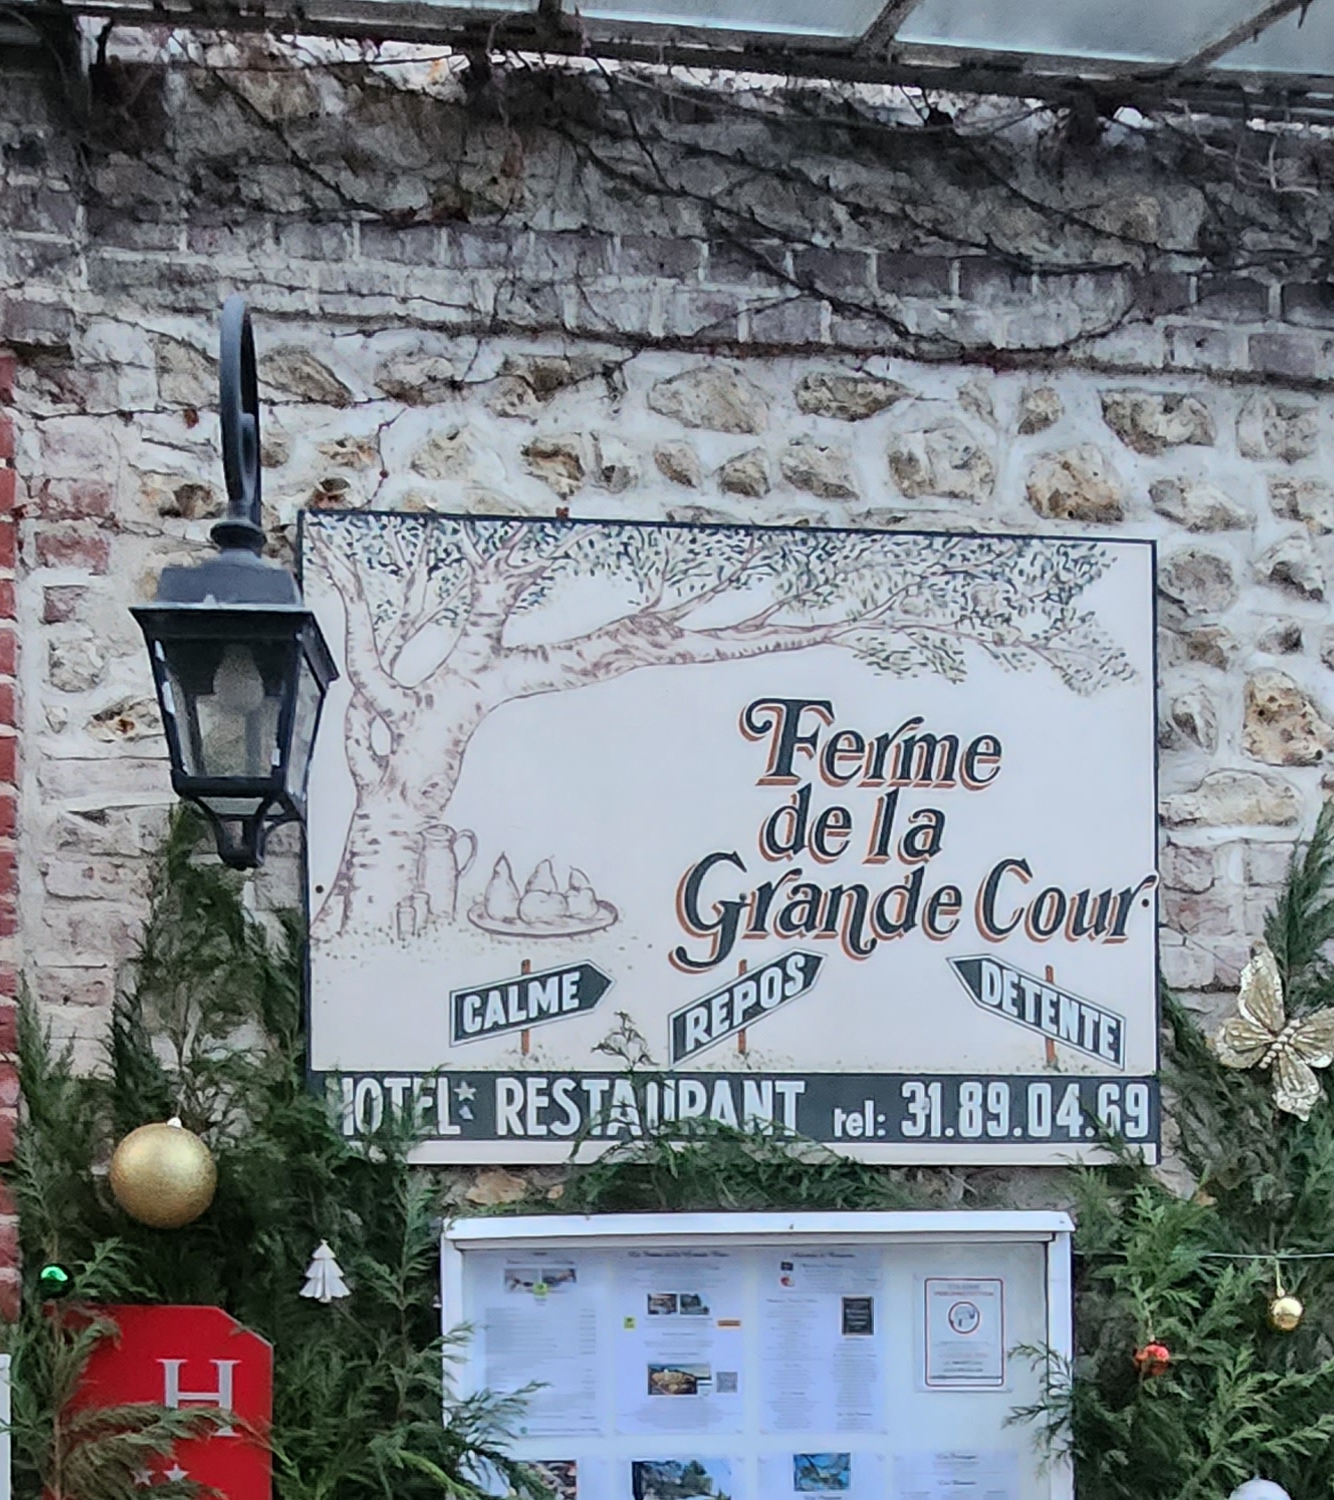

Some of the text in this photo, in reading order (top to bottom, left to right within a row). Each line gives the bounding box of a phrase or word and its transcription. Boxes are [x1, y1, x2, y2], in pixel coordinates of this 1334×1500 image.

[740, 697, 1003, 791] Ferme
[759, 783, 946, 864] de la
[668, 851, 1157, 974] Grande Cour
[461, 971, 581, 1035] CALME
[685, 953, 808, 1052] REPOS
[980, 959, 1117, 1061] DETENTE
[495, 1077, 805, 1138] RESTAURANT
[900, 1081, 1149, 1138] 31.89.04.69
[156, 1358, 242, 1437] H
